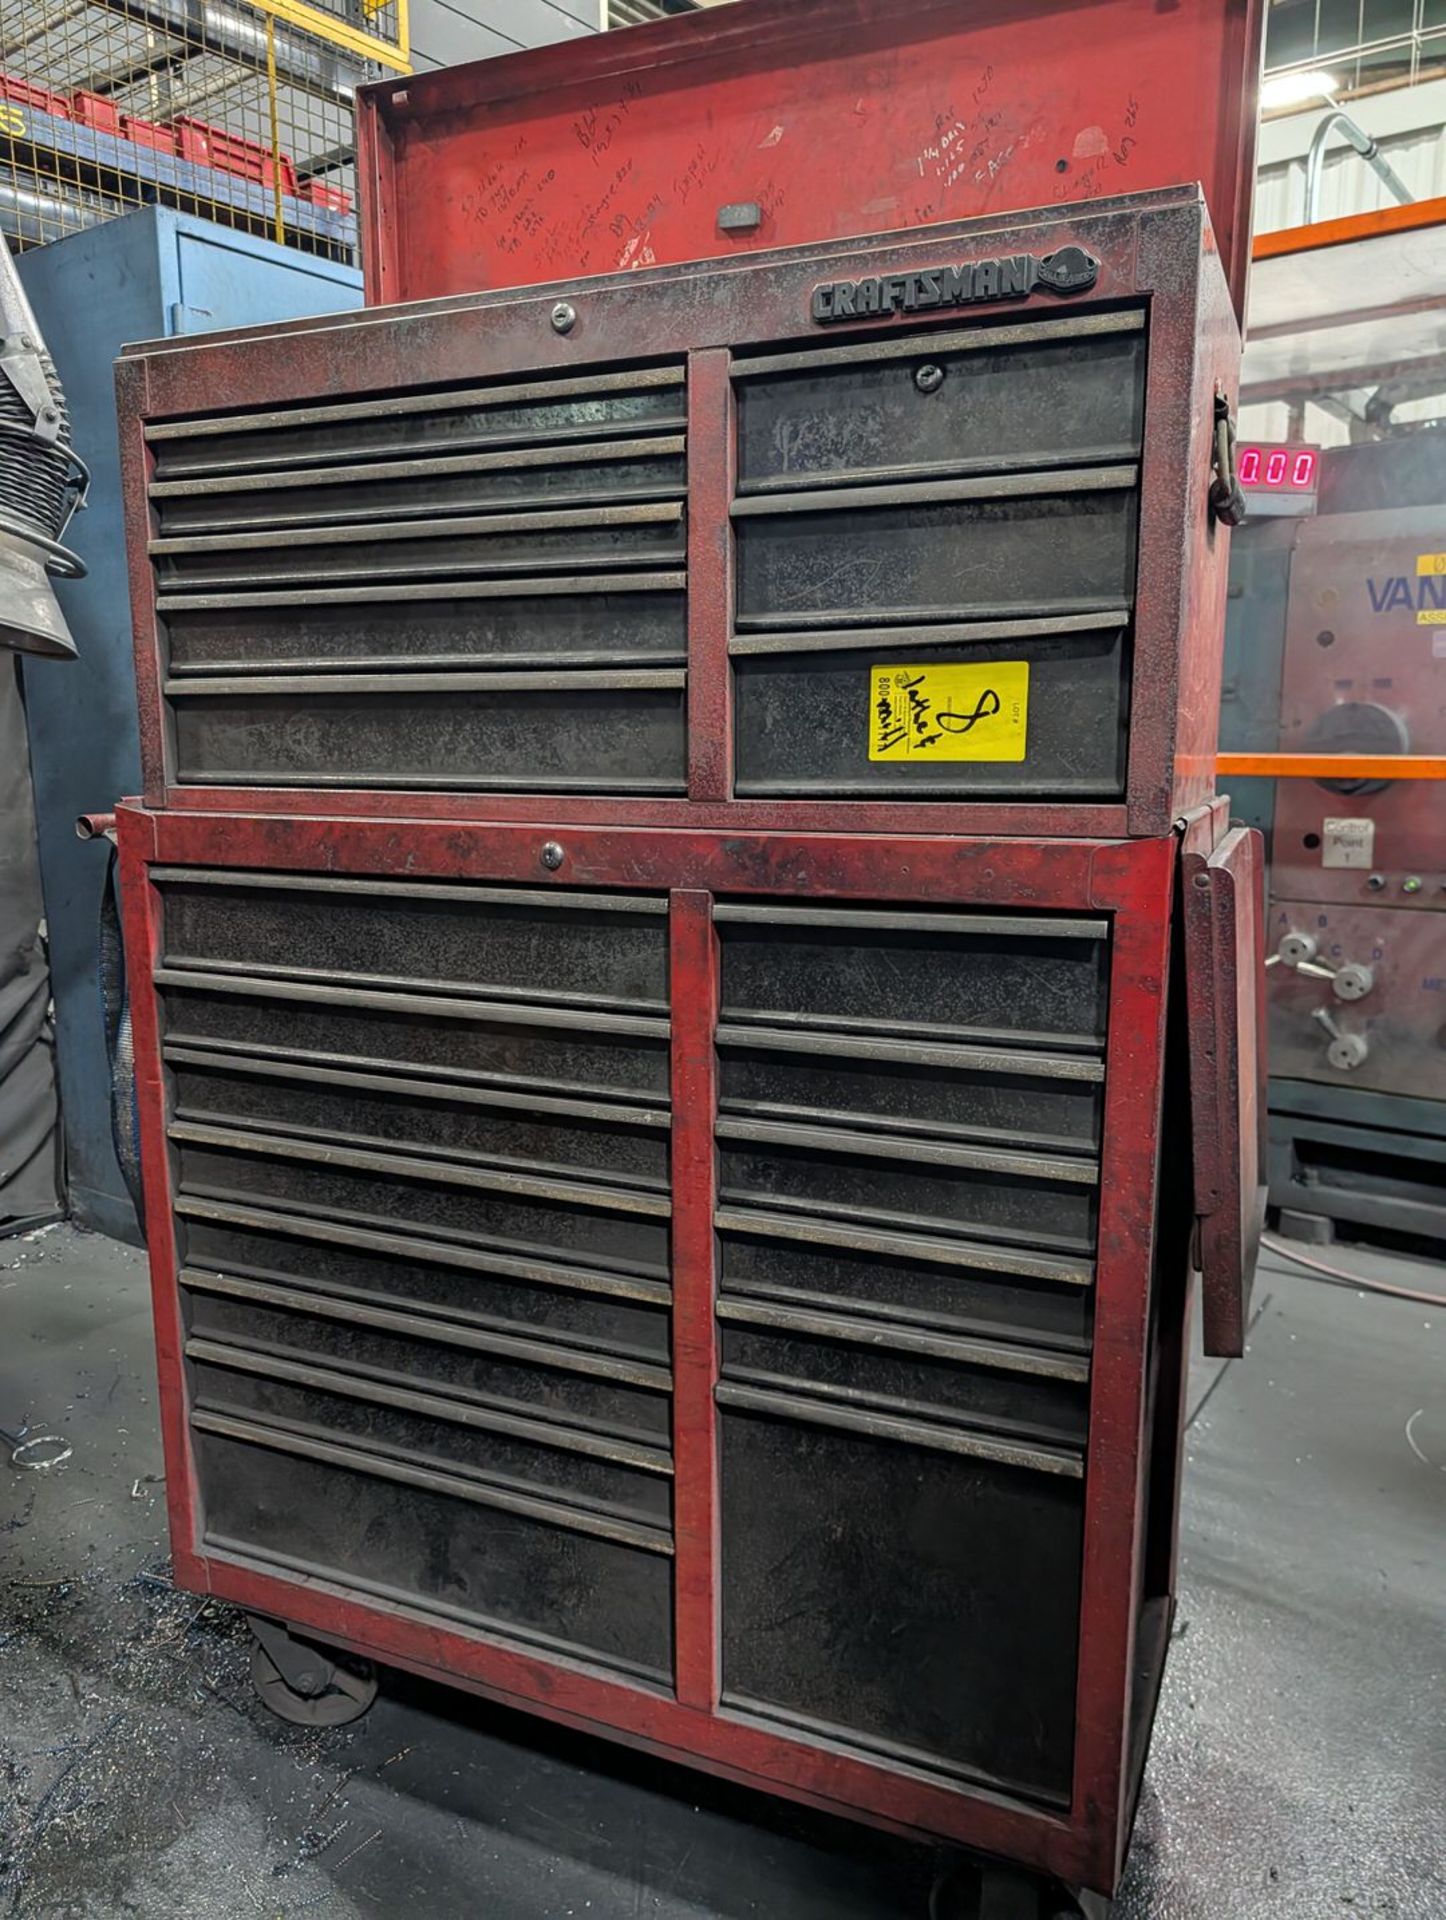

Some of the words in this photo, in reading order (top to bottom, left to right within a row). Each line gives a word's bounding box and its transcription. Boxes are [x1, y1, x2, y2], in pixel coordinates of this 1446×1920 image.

[812, 253, 1034, 324] CRAFTSMAN
[1366, 576, 1446, 612] VAN
[935, 689, 1000, 734] 8
